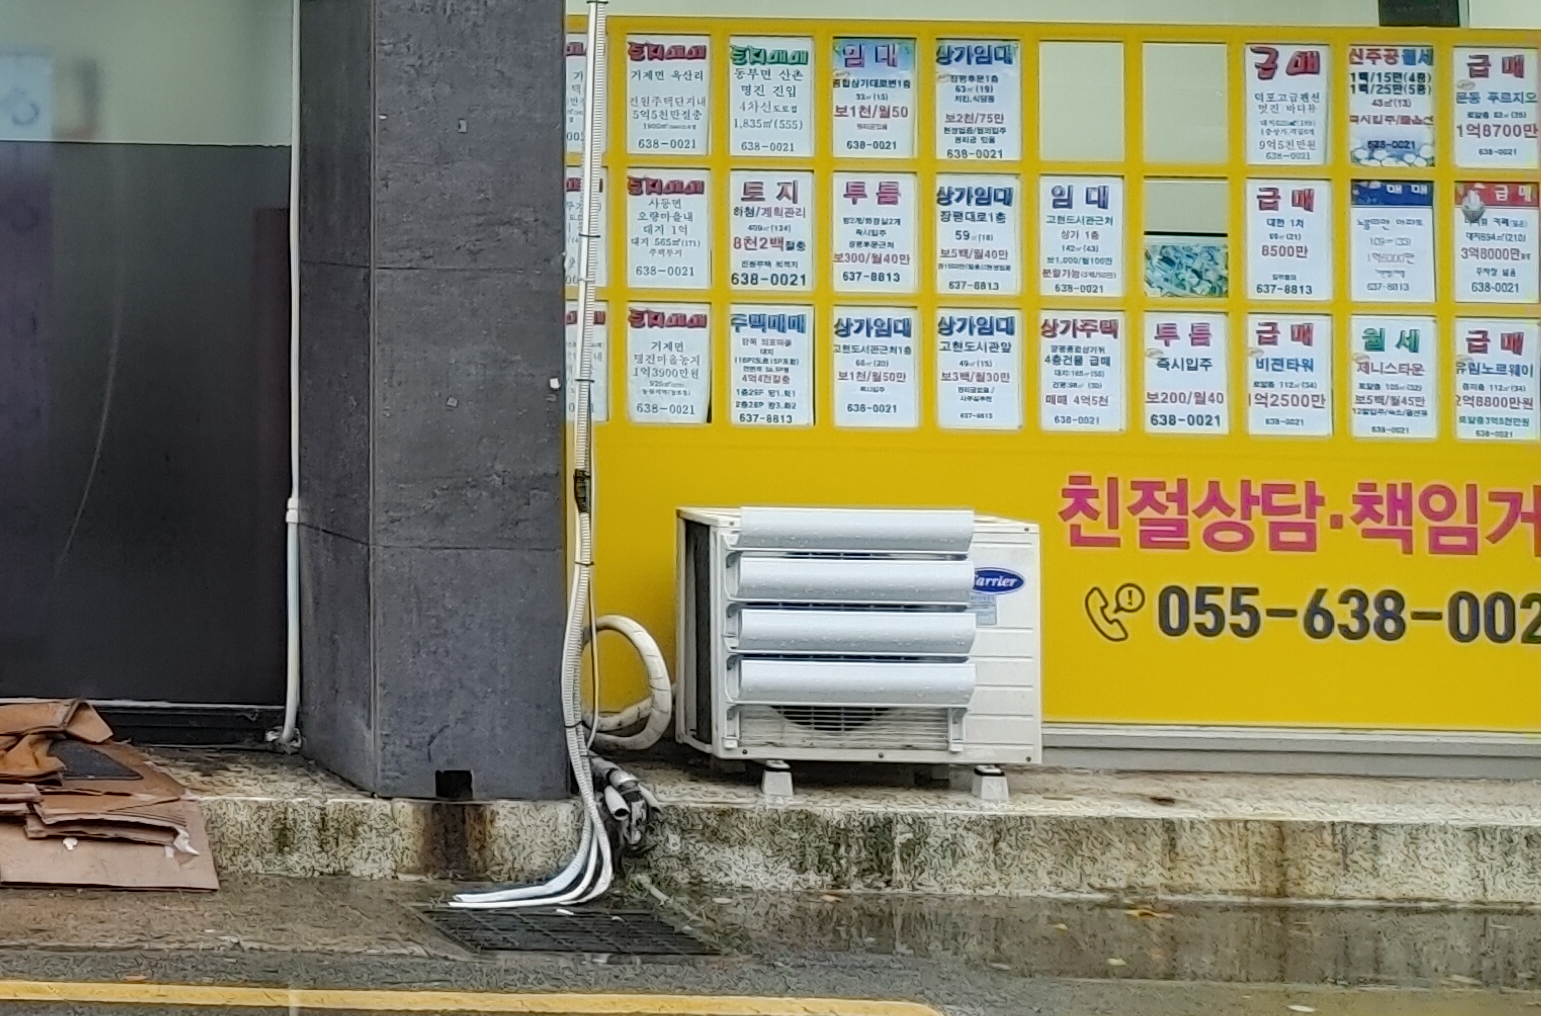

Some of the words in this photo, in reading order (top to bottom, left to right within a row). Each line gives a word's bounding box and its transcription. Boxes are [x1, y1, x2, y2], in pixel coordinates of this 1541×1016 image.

[935, 44, 1014, 66] 상가임대
[1466, 54, 1525, 79] 급매
[833, 104, 909, 119] 보1천/월50
[1455, 124, 1539, 139] 1억8700만
[637, 138, 697, 149] 638-0021
[740, 141, 795, 152] 638-0021
[846, 140, 897, 150] 638-0021
[946, 149, 1004, 159] 638-0021
[740, 179, 799, 204] 토지
[842, 181, 902, 206] 투룸
[935, 185, 1014, 207] 상가임대
[1050, 184, 1110, 210] 임대
[1255, 186, 1315, 213] 급매
[832, 252, 911, 266] 보300/월40만
[635, 266, 695, 278] 638-0021
[730, 272, 807, 287] 638-0021
[842, 271, 901, 283] 637-8813
[948, 280, 1000, 291] 637-8813
[1054, 283, 1104, 294] 638-0021
[1255, 283, 1313, 295] 637-8813
[1471, 282, 1520, 293] 638-0021
[833, 317, 913, 339] 상가임대
[937, 315, 1016, 336] 상가임대
[1040, 318, 1120, 340] 상가주택
[1153, 322, 1213, 348] 투룸
[1255, 321, 1315, 347] 급매
[1361, 327, 1421, 354] 월세
[1465, 329, 1525, 356] 급매
[1155, 357, 1214, 372] 즉시입주
[1144, 391, 1225, 406] 보200/월40
[1248, 392, 1327, 409] 1억2500만
[636, 402, 696, 416] 638-0021
[846, 403, 898, 414] 638-0021
[739, 413, 793, 424] 637-8813
[1053, 415, 1101, 425] 638-0021
[1149, 413, 1222, 427] 638-0021
[974, 574, 1018, 587] arrier
